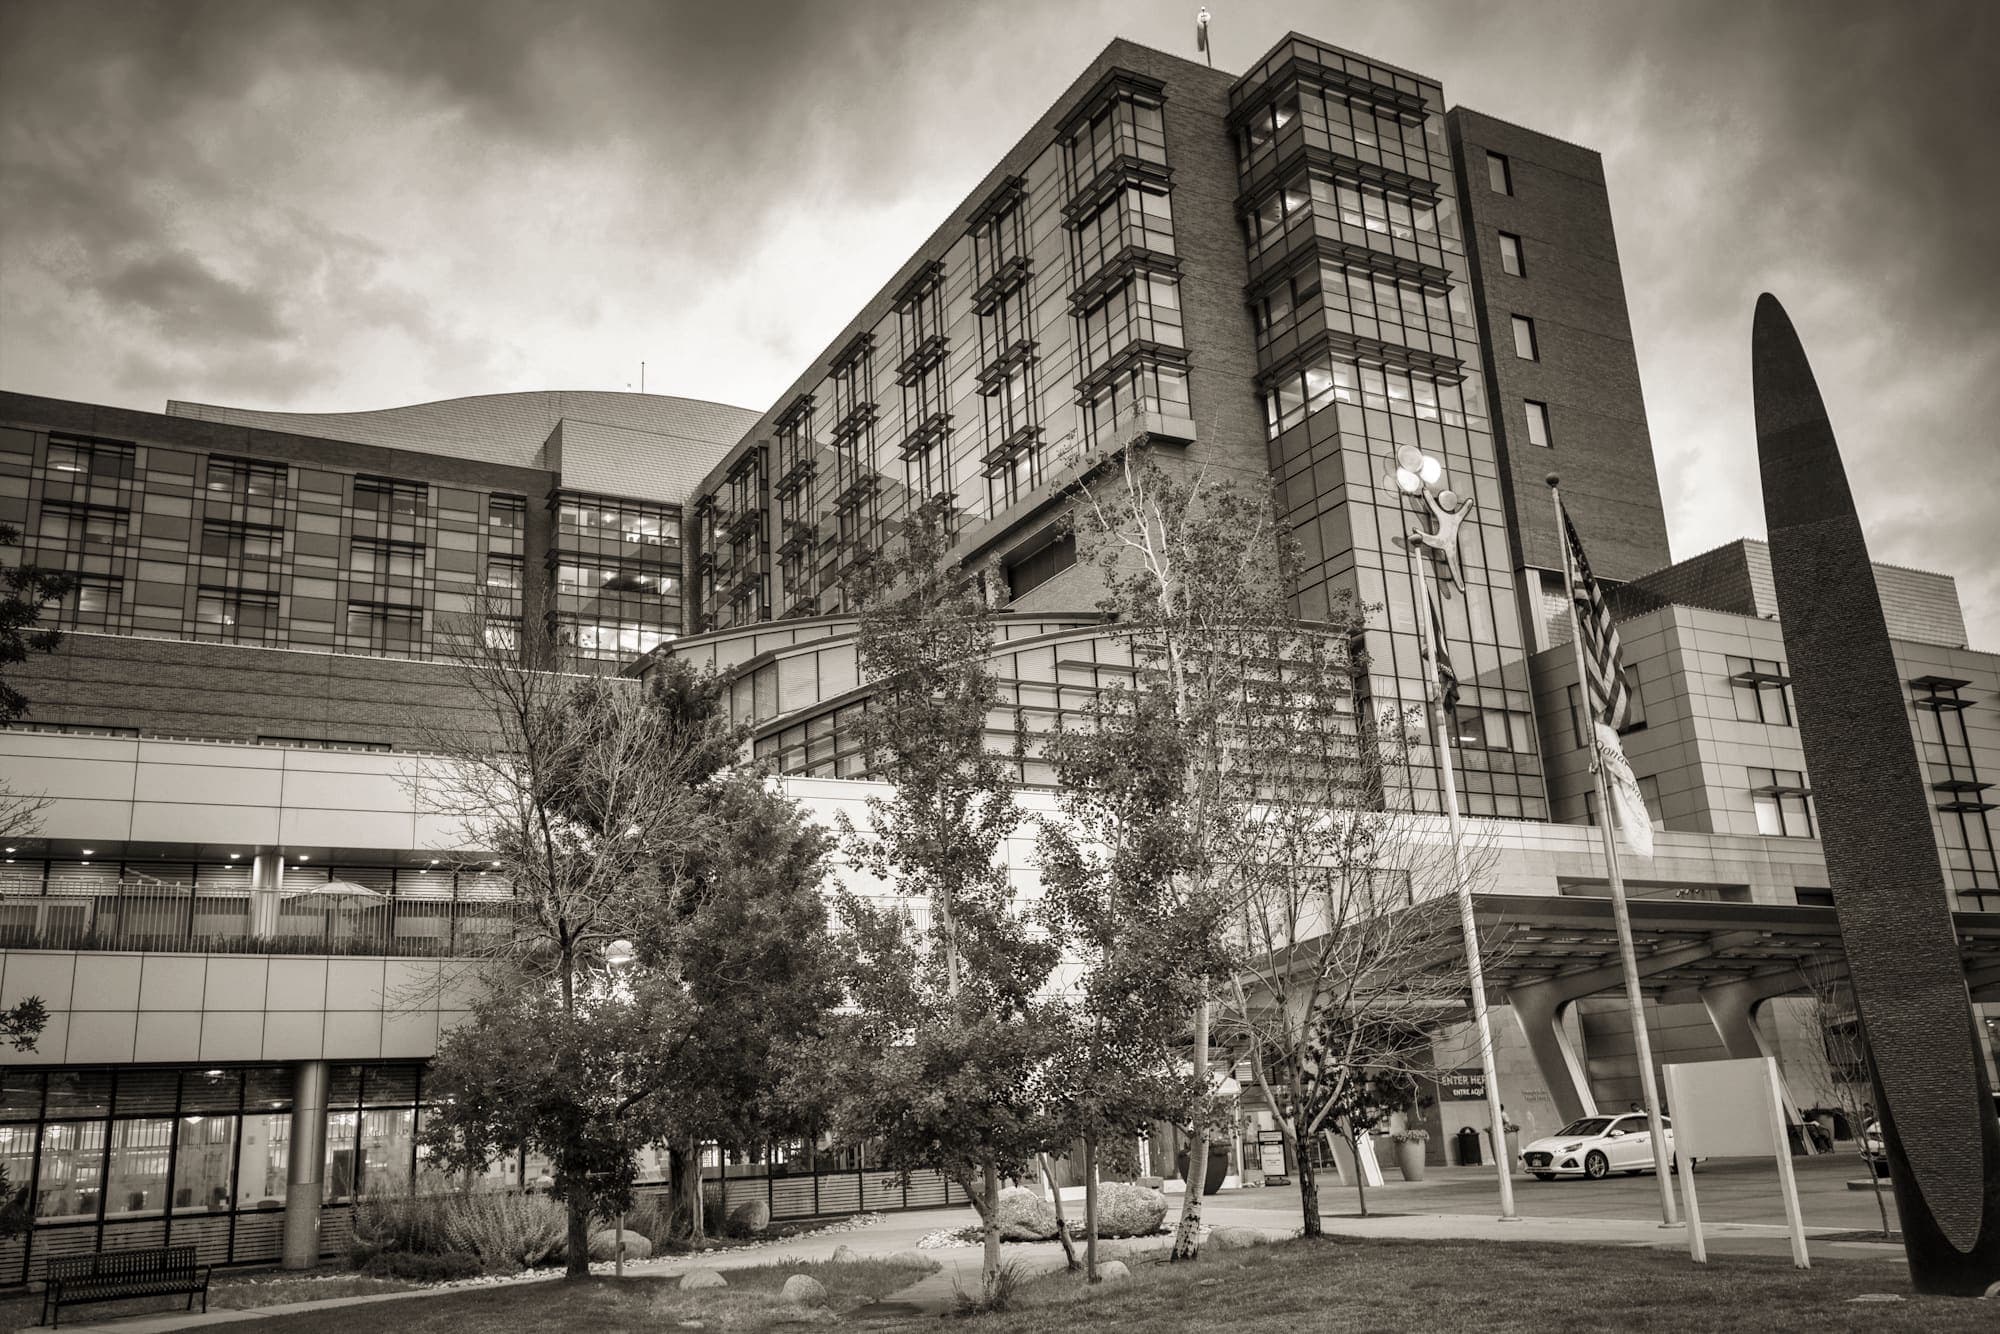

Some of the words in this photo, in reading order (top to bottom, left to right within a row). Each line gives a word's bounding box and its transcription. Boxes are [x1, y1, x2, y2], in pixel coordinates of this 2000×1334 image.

[1441, 1075, 1469, 1086] ENTER
[1470, 1075, 1487, 1085] HER
[1452, 1088, 1470, 1097] ENTRE
